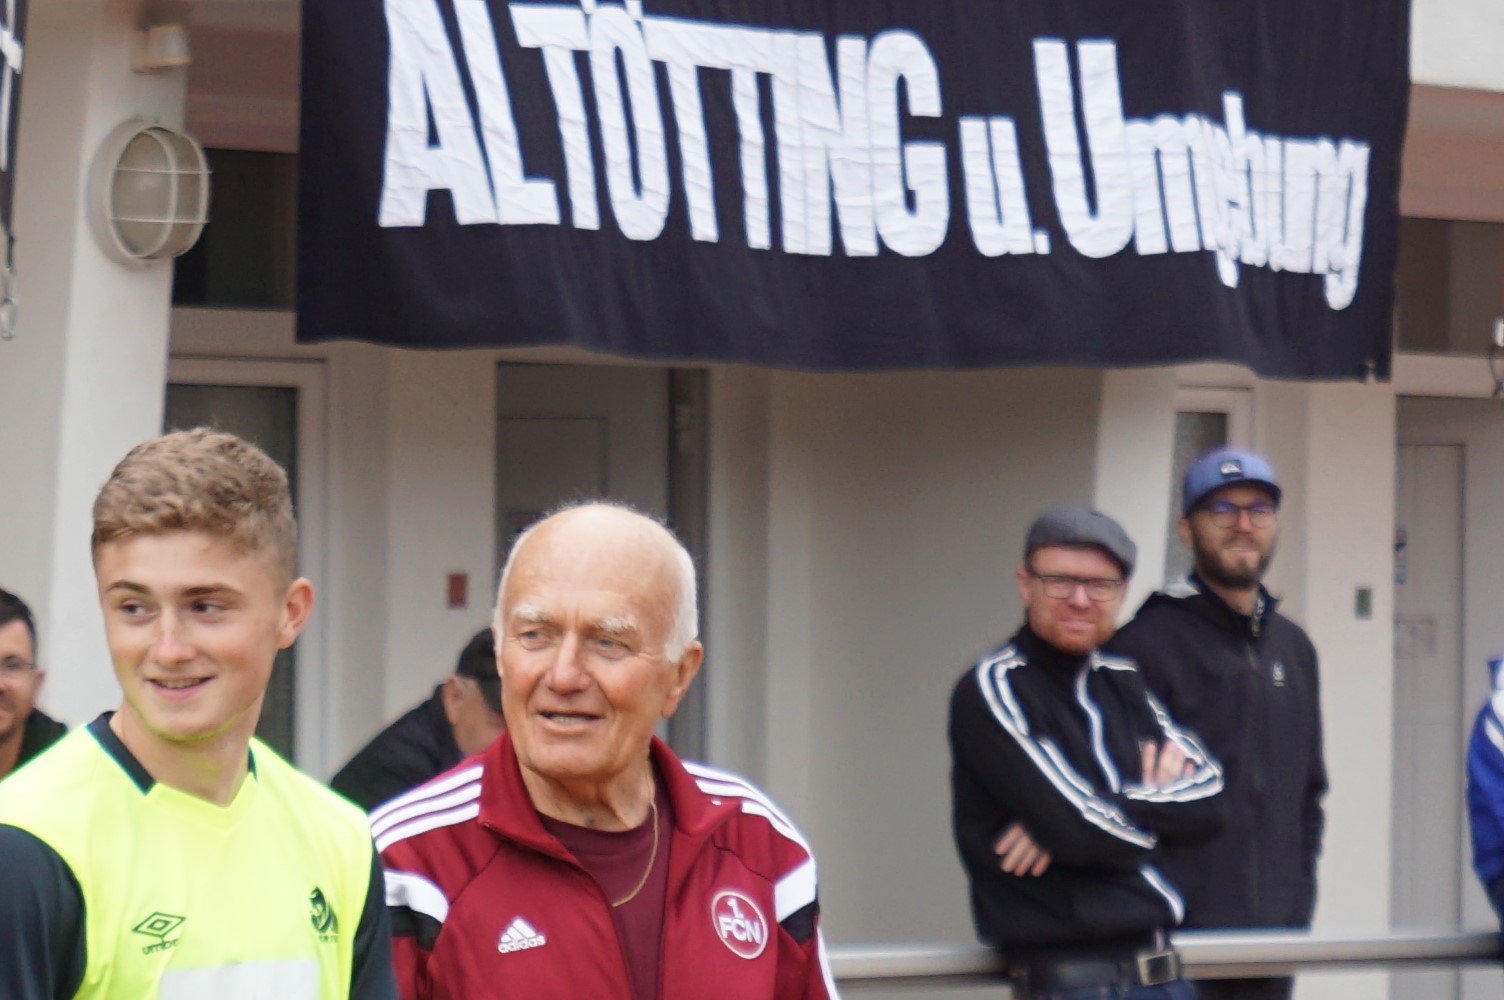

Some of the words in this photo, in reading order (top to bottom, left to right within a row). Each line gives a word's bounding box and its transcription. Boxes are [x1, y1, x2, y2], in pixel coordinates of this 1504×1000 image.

[959, 116, 1050, 257] u.
[719, 915, 761, 944] FCN
[142, 936, 180, 955] umbr
[498, 935, 546, 953] adidas
